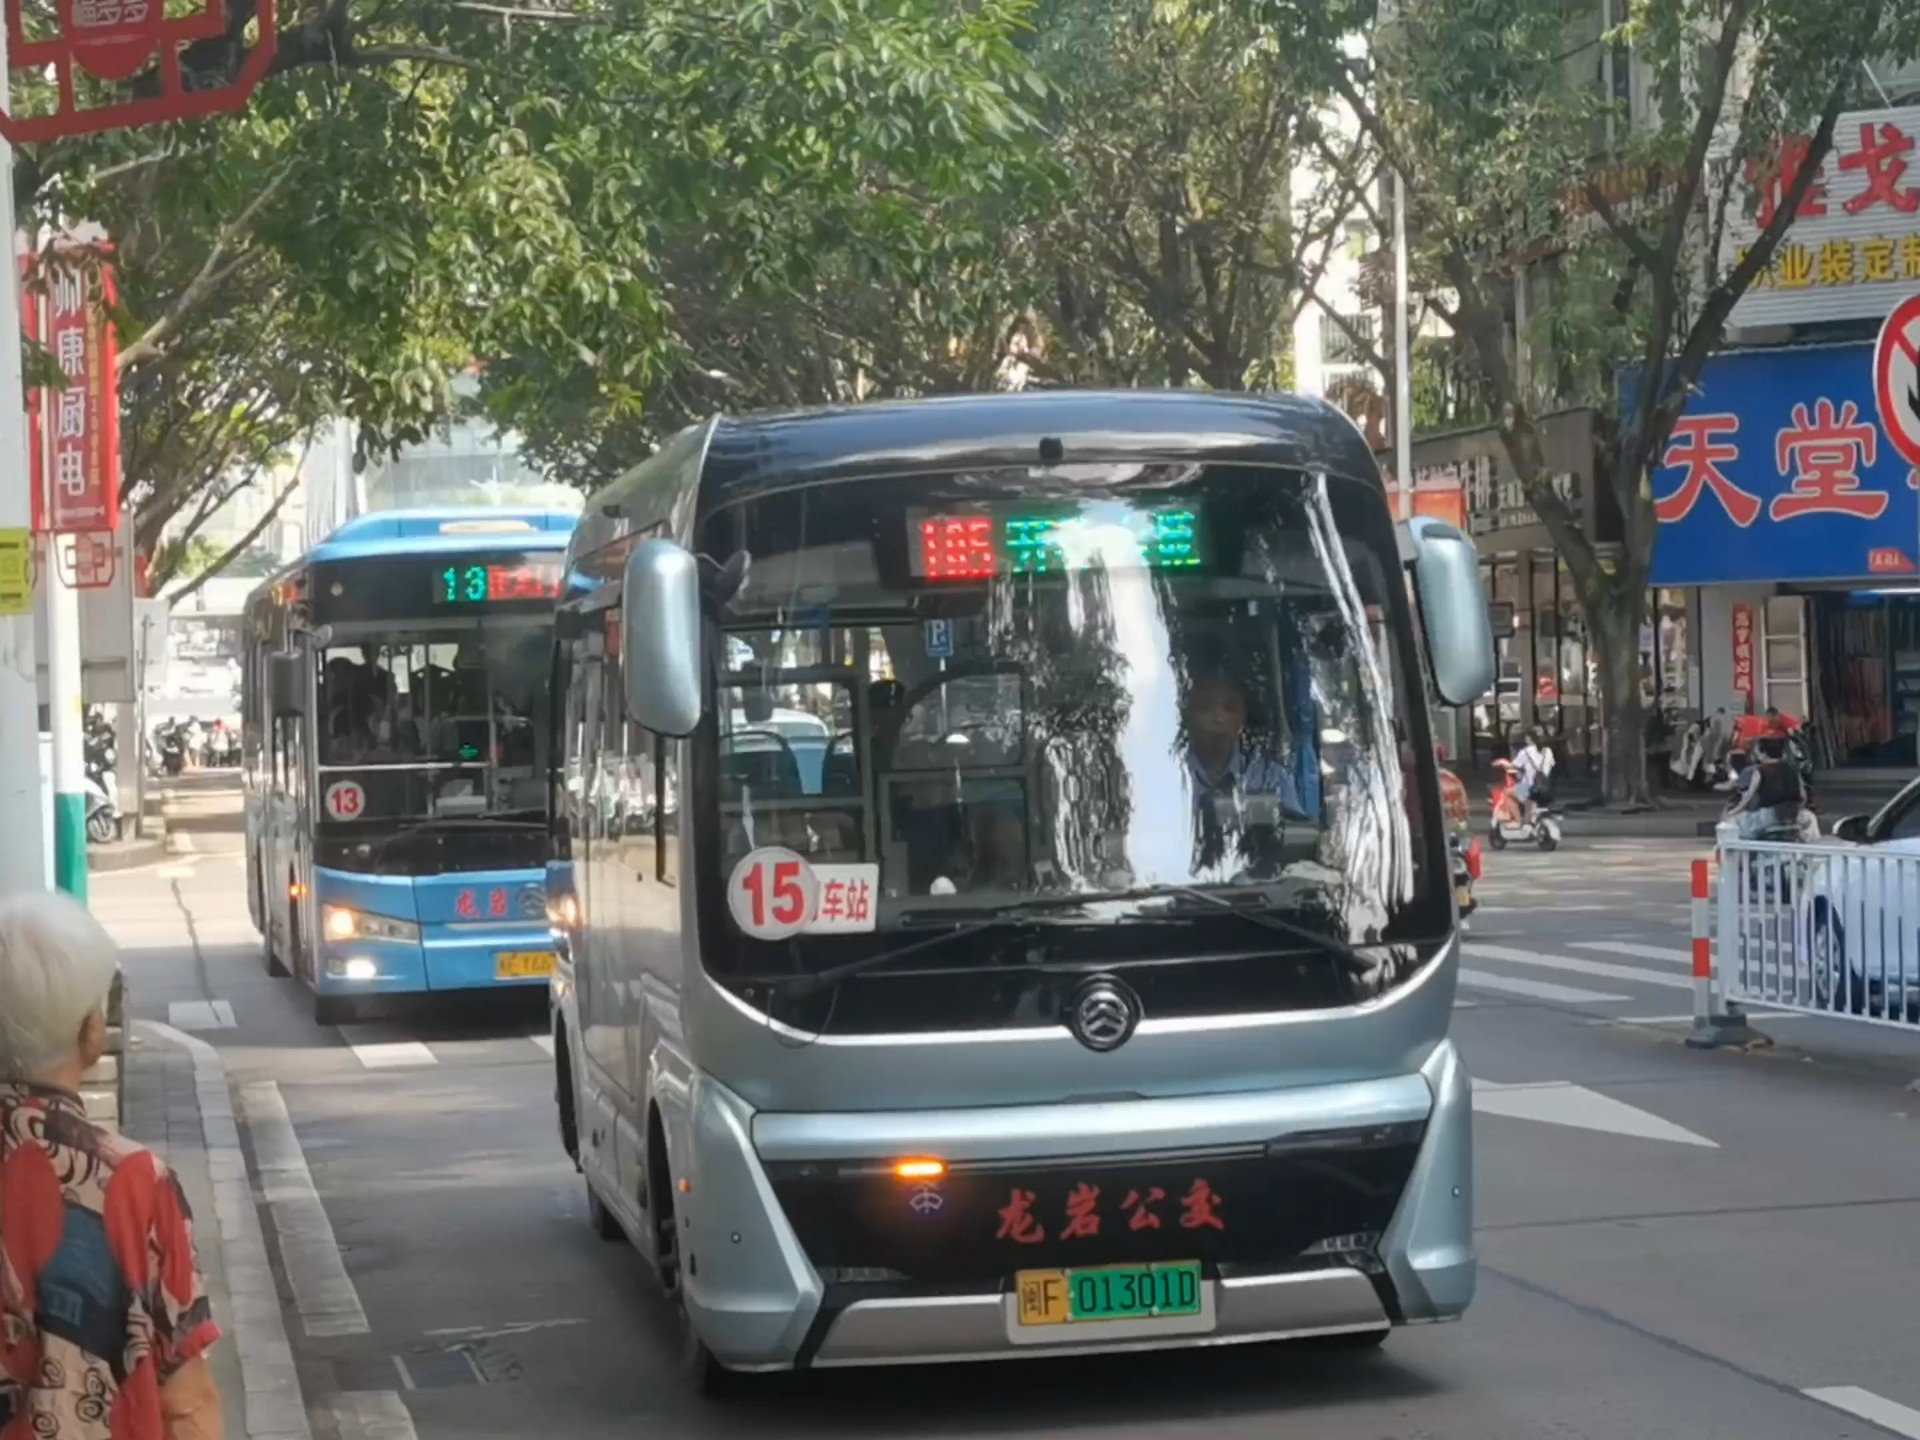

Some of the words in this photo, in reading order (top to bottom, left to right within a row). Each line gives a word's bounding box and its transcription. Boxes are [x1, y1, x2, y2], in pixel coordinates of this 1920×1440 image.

[443, 567, 487, 601] 13
[332, 788, 359, 813] 13
[742, 861, 804, 926] 15
[813, 877, 869, 923] 车站
[996, 1178, 1225, 1243] 龙岩公交
